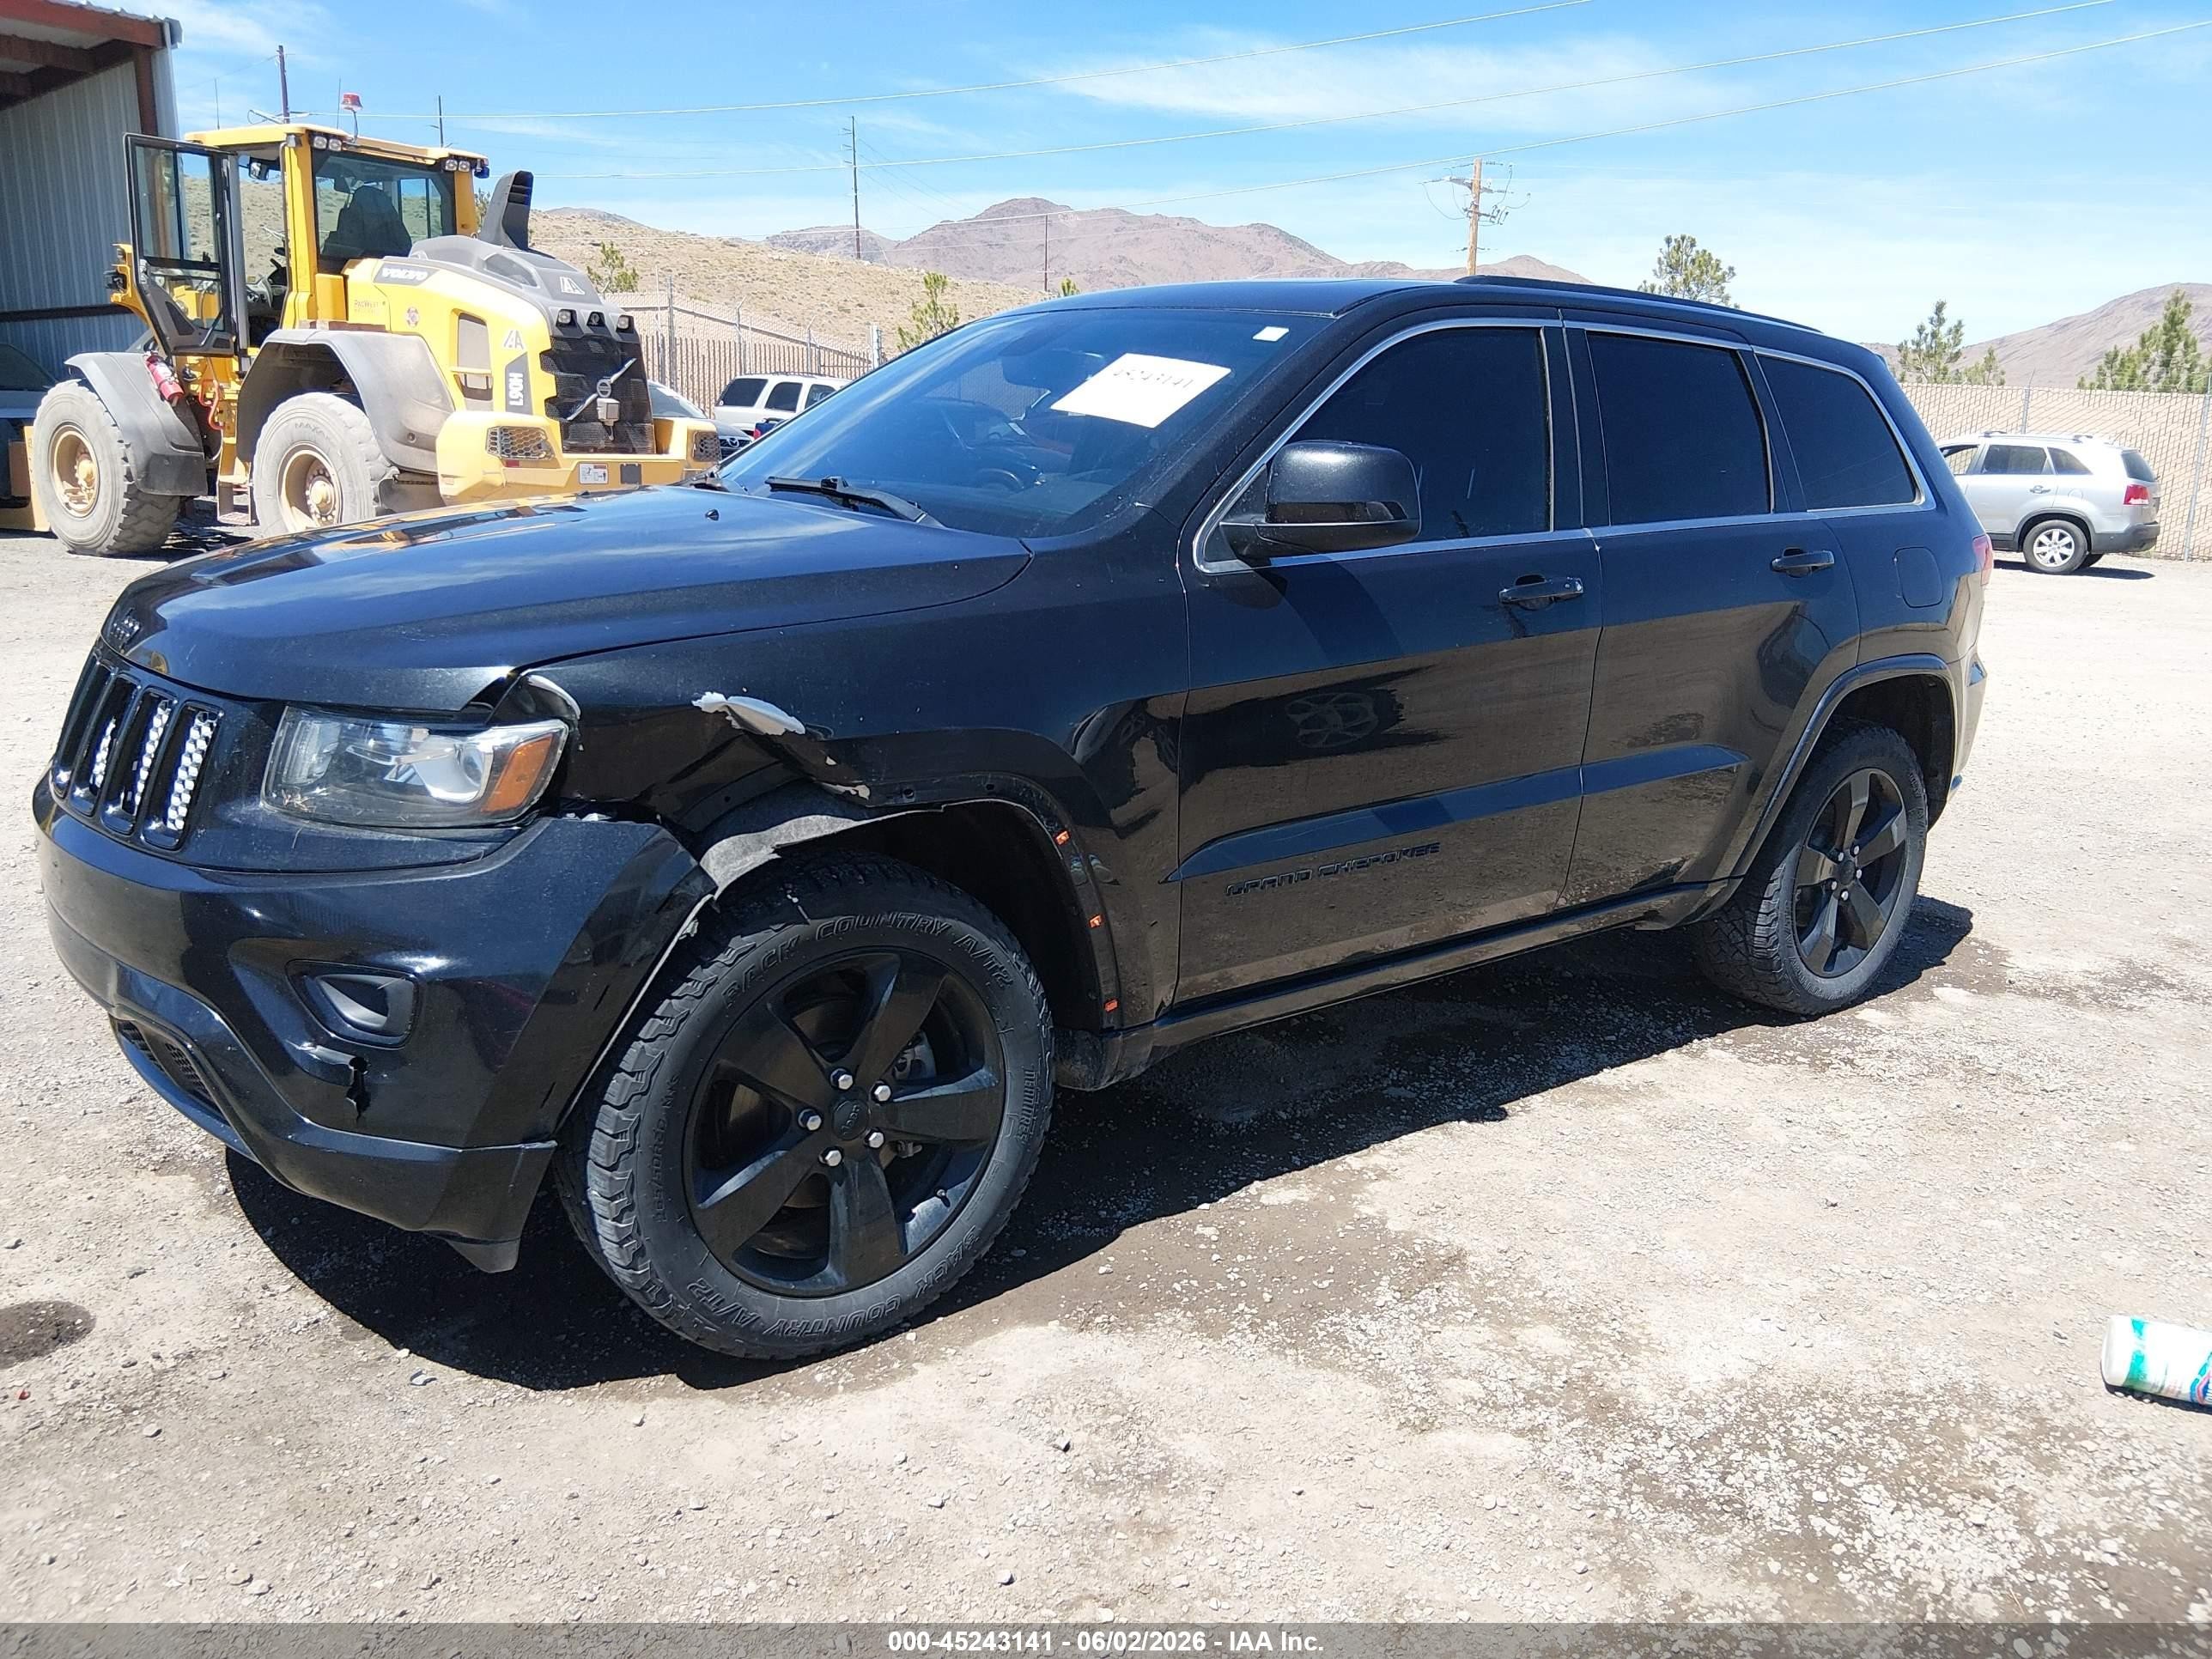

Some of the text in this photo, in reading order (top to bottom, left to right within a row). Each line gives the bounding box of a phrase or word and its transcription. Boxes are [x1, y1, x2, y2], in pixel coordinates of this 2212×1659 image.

[381, 267, 428, 282] VOLVO
[508, 372, 524, 406] L90H
[1224, 842, 1441, 896] GRAND CHEROKEE
[720, 913, 1015, 1008] BACK COUNTRY A/T2
[686, 1278, 762, 1327] A/T2
[763, 1293, 902, 1338] COUNTRY
